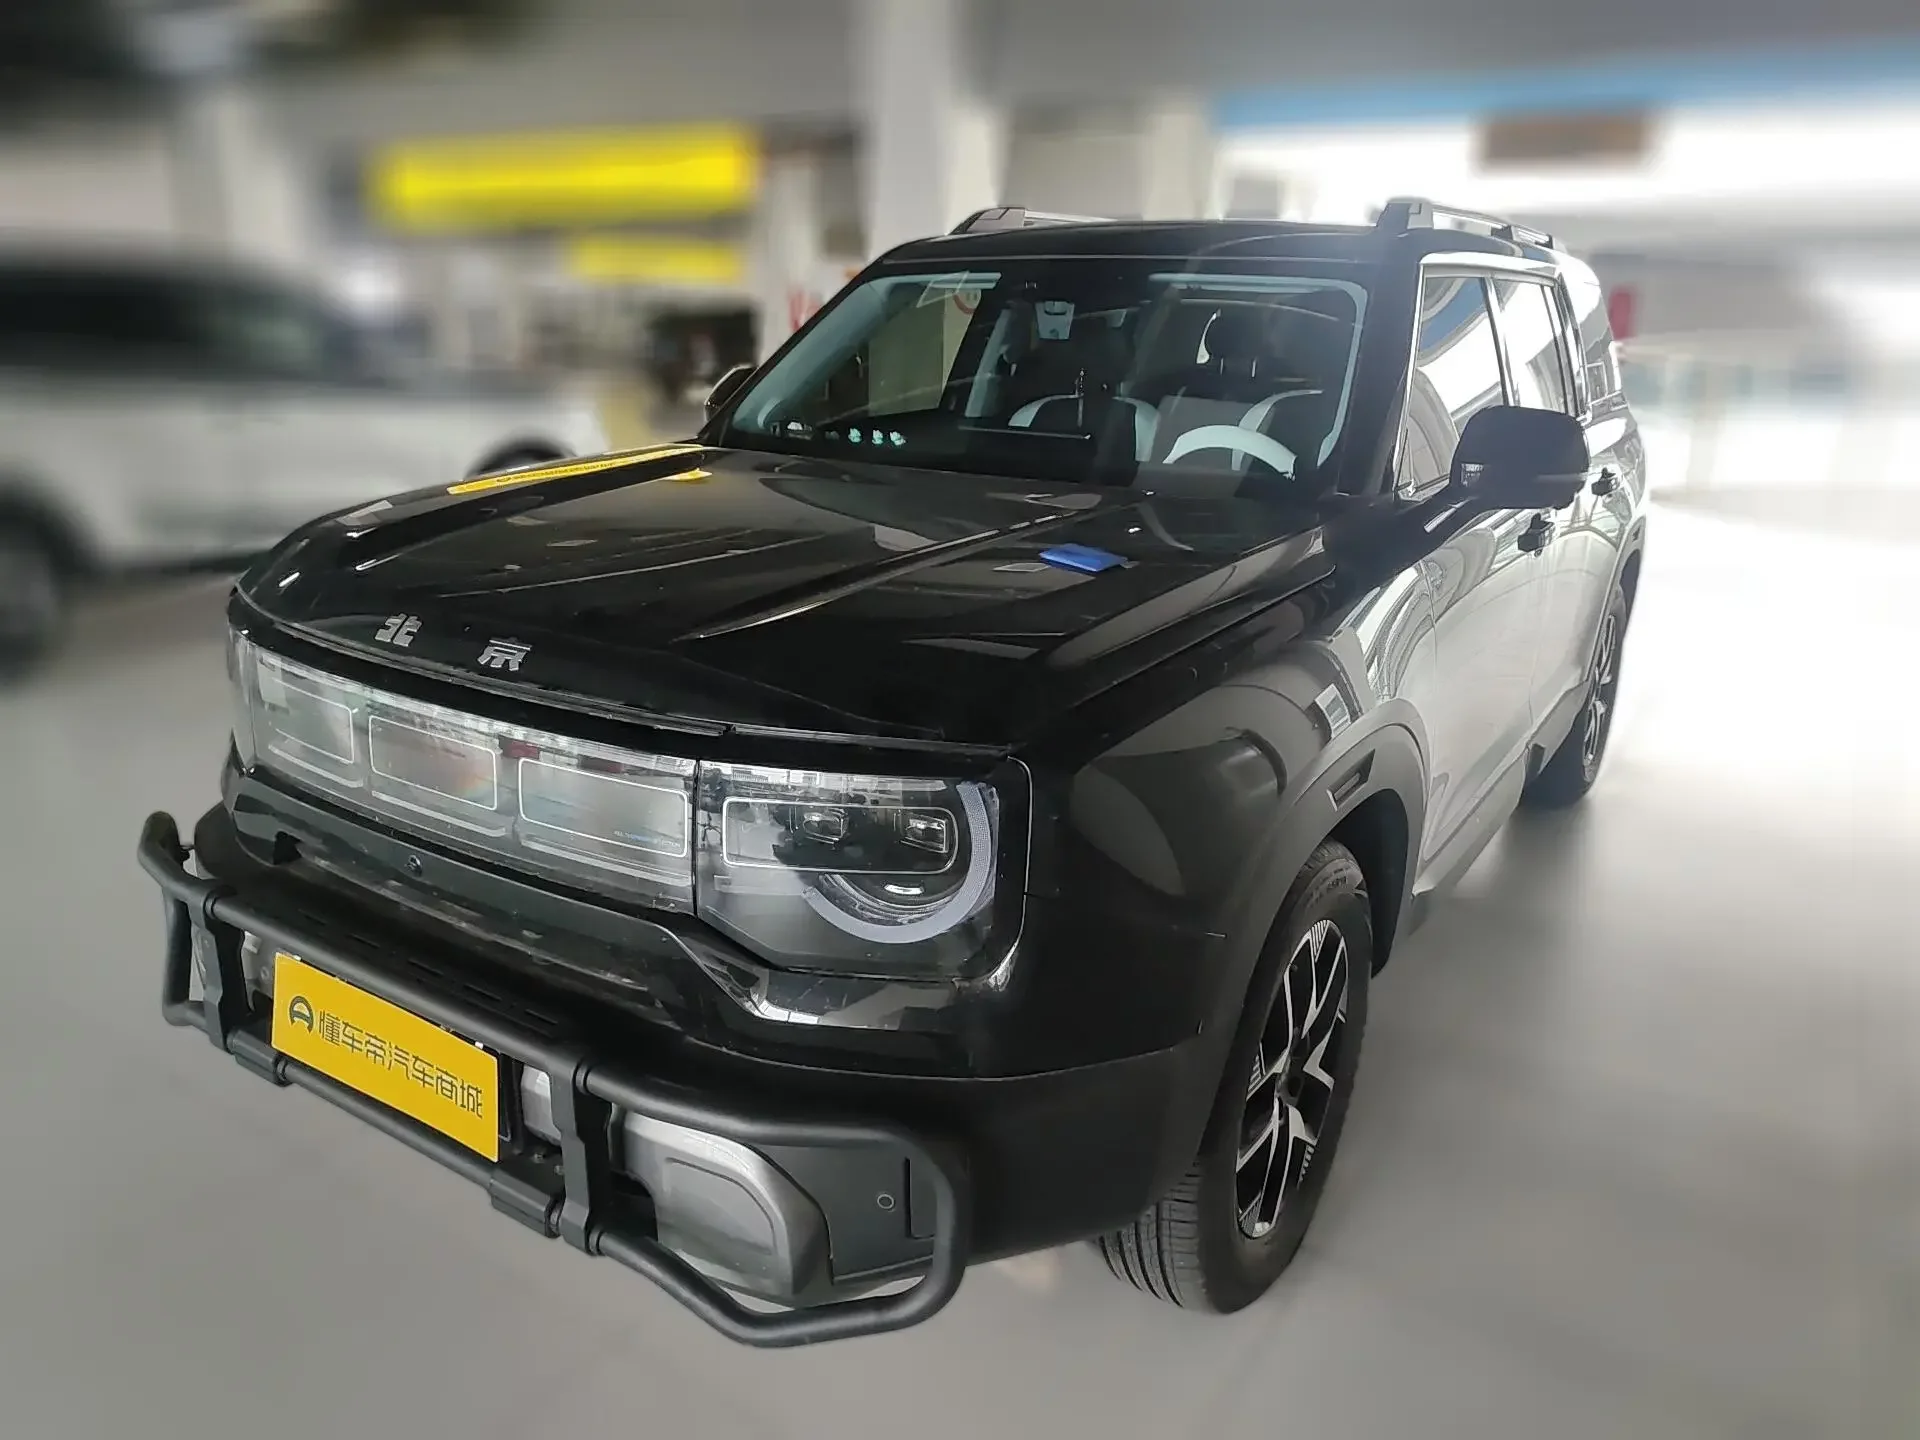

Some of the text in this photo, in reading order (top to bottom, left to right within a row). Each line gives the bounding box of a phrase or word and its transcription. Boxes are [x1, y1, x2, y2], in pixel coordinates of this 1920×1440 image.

[375, 613, 532, 672] 北京
[318, 1010, 483, 1119] 懂车帝汽车商城
